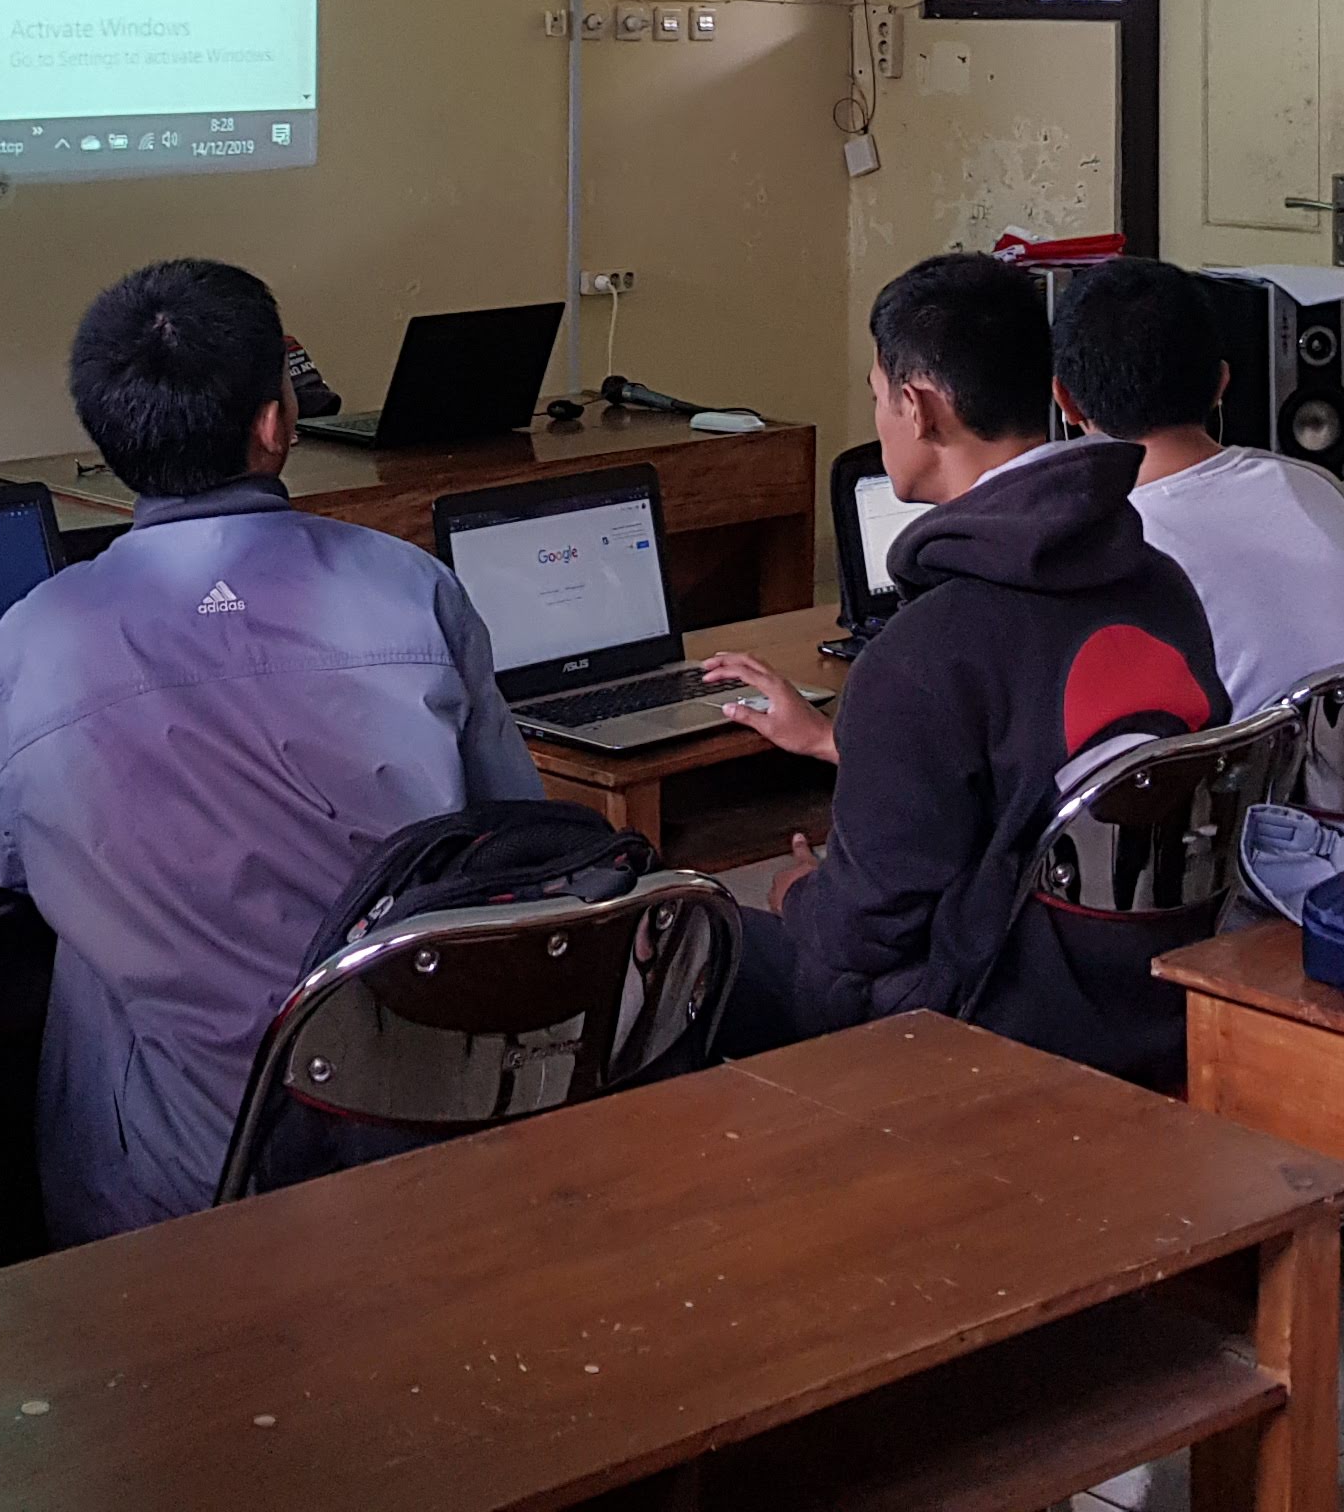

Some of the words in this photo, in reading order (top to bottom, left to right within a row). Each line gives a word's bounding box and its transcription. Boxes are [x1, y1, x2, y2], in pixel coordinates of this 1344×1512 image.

[11, 19, 94, 39] Activate
[101, 18, 190, 37] Windows
[192, 140, 254, 157] 14/12/2019
[538, 545, 578, 564] Google
[197, 599, 246, 614] adidas
[562, 658, 589, 672] ASUS
